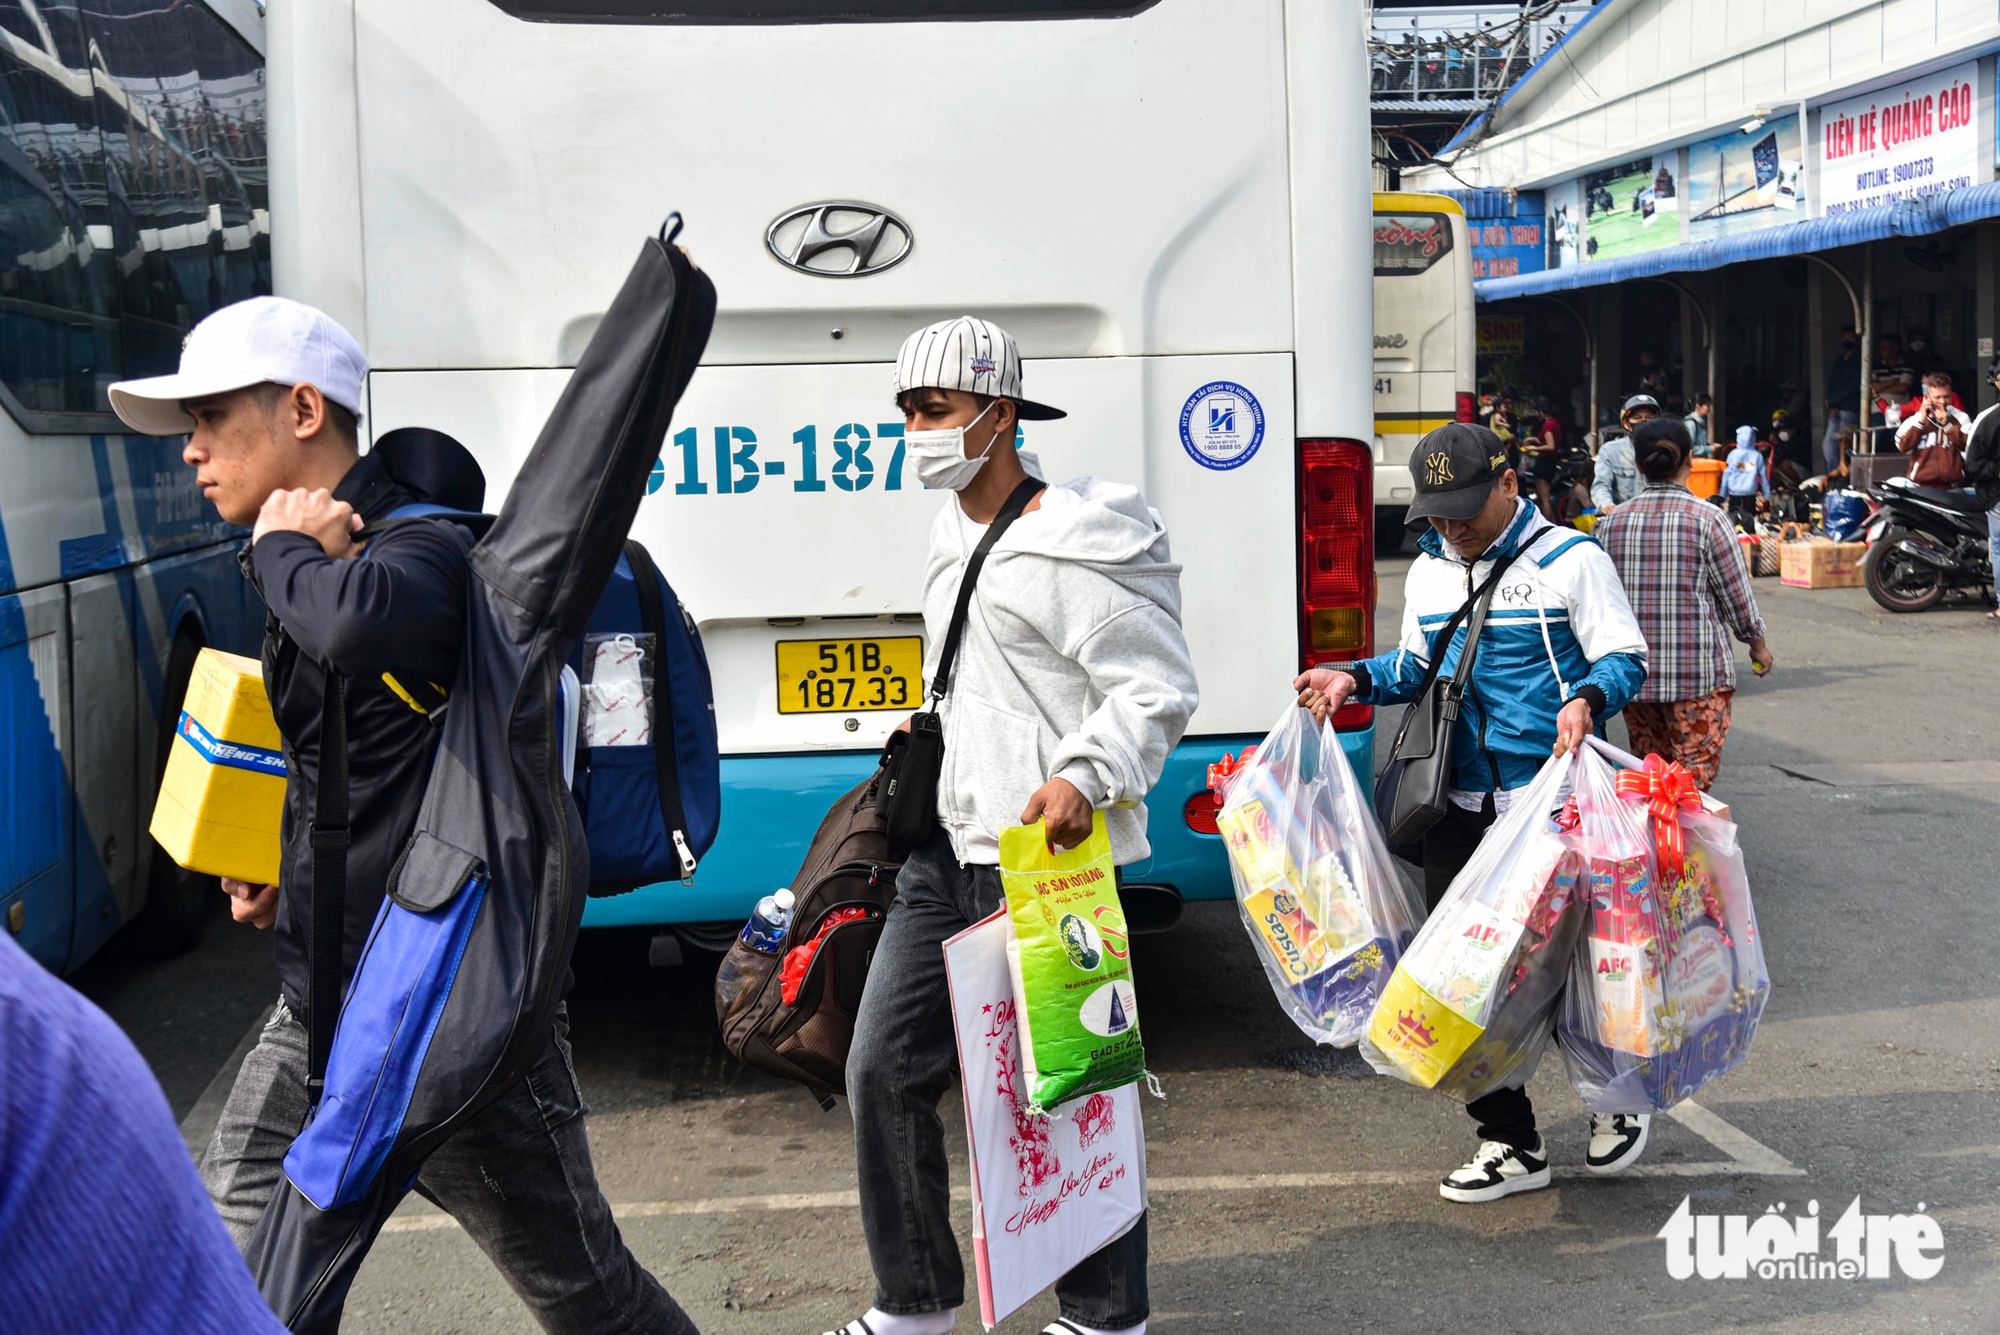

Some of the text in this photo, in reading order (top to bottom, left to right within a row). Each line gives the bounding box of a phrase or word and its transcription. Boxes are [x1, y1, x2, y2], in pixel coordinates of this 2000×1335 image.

[1826, 79, 1971, 160] LIÊN HỆ QUẢNG CÁO
[1856, 156, 1934, 190] HOTLINE: 19007373
[819, 642, 880, 673] 51B
[798, 676, 907, 708] 187.33
[1265, 912, 1309, 978] Custas
[1268, 934, 1283, 958] ORION
